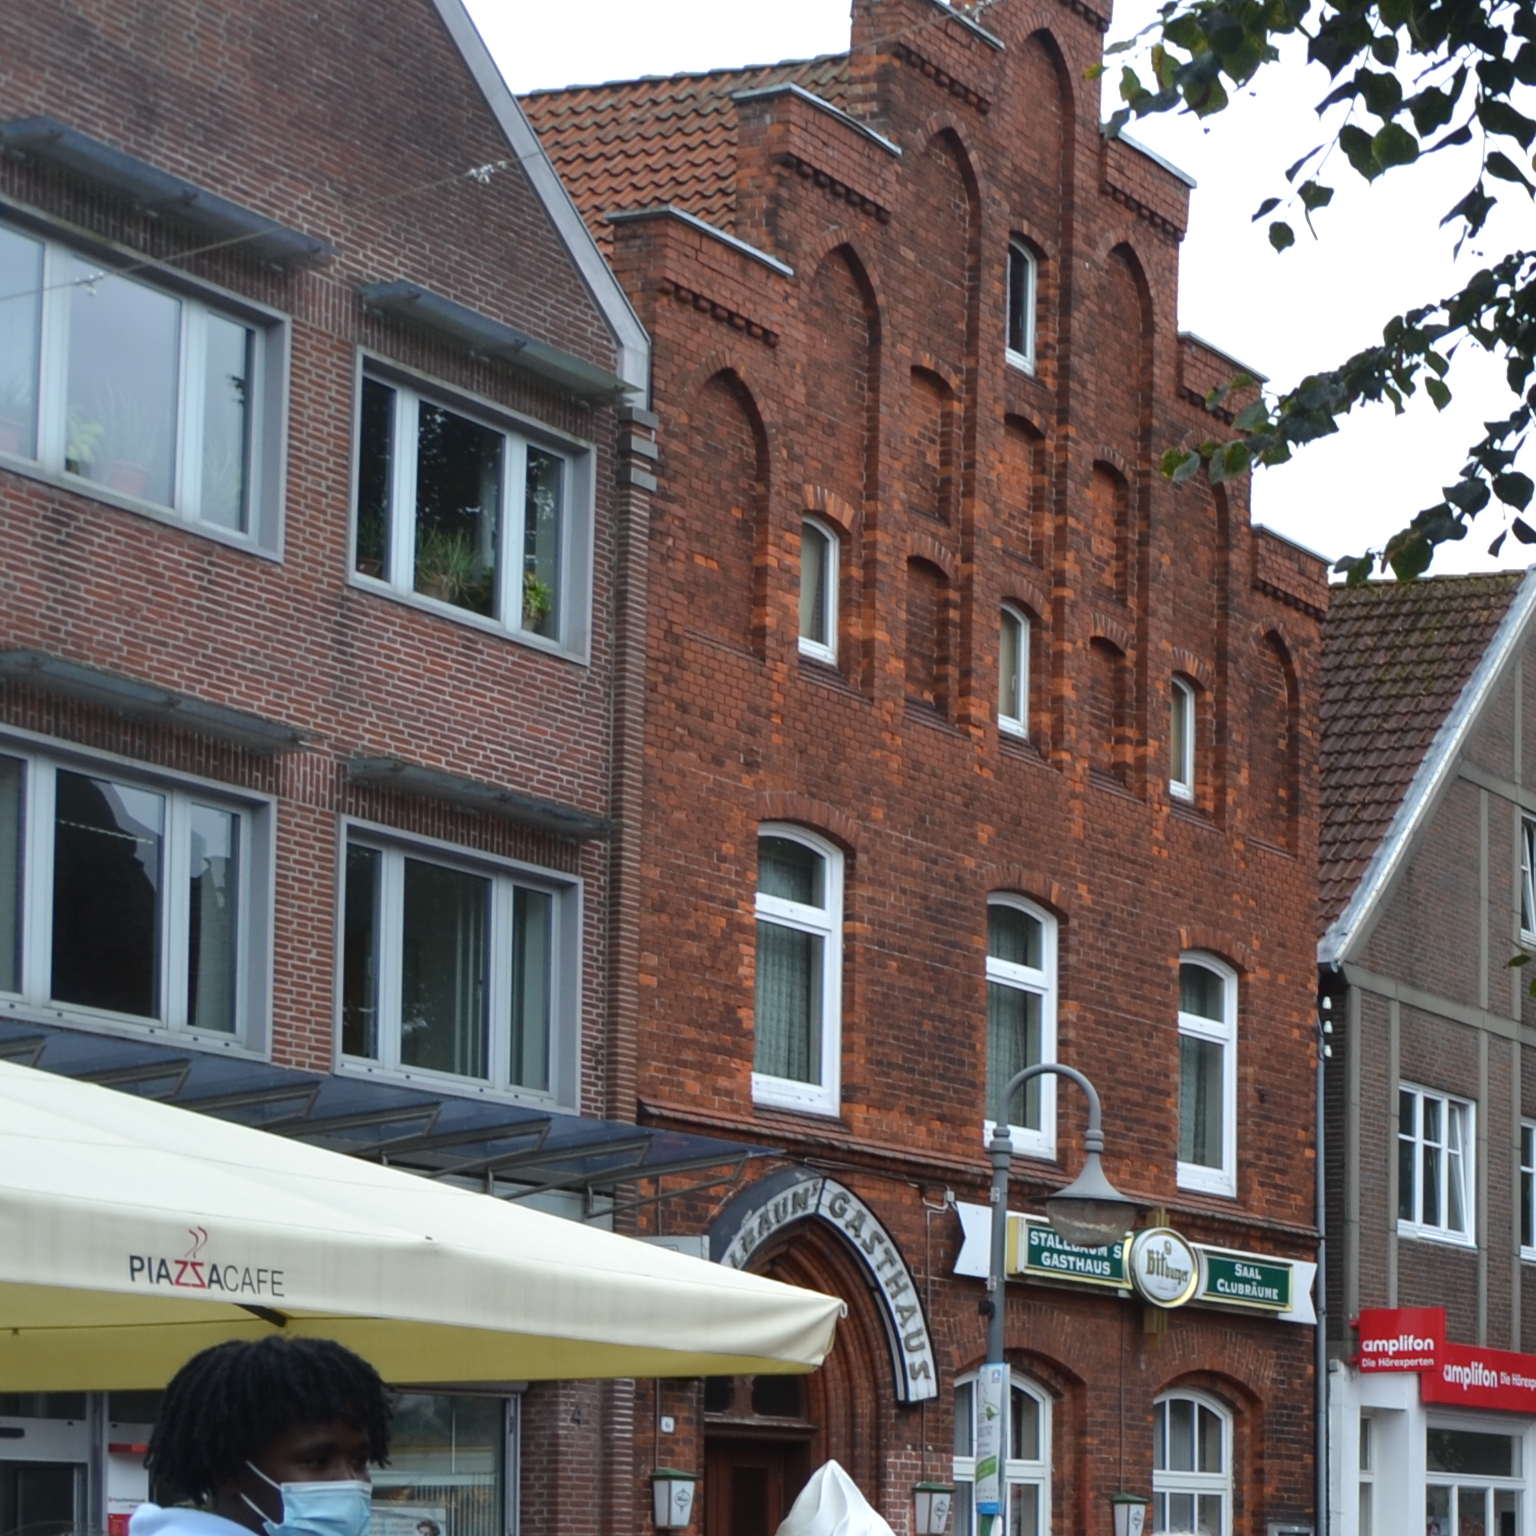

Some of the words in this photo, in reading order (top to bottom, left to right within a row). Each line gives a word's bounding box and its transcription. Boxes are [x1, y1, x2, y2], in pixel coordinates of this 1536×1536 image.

[1041, 1250, 1112, 1276] GASTHAUS
[829, 1191, 932, 1382] GASTHAUS
[1362, 1334, 1434, 1356] amplifon
[1362, 1357, 1376, 1368] Die
[1378, 1356, 1434, 1369] Hörexperten
[1443, 1361, 1498, 1391] amplifon
